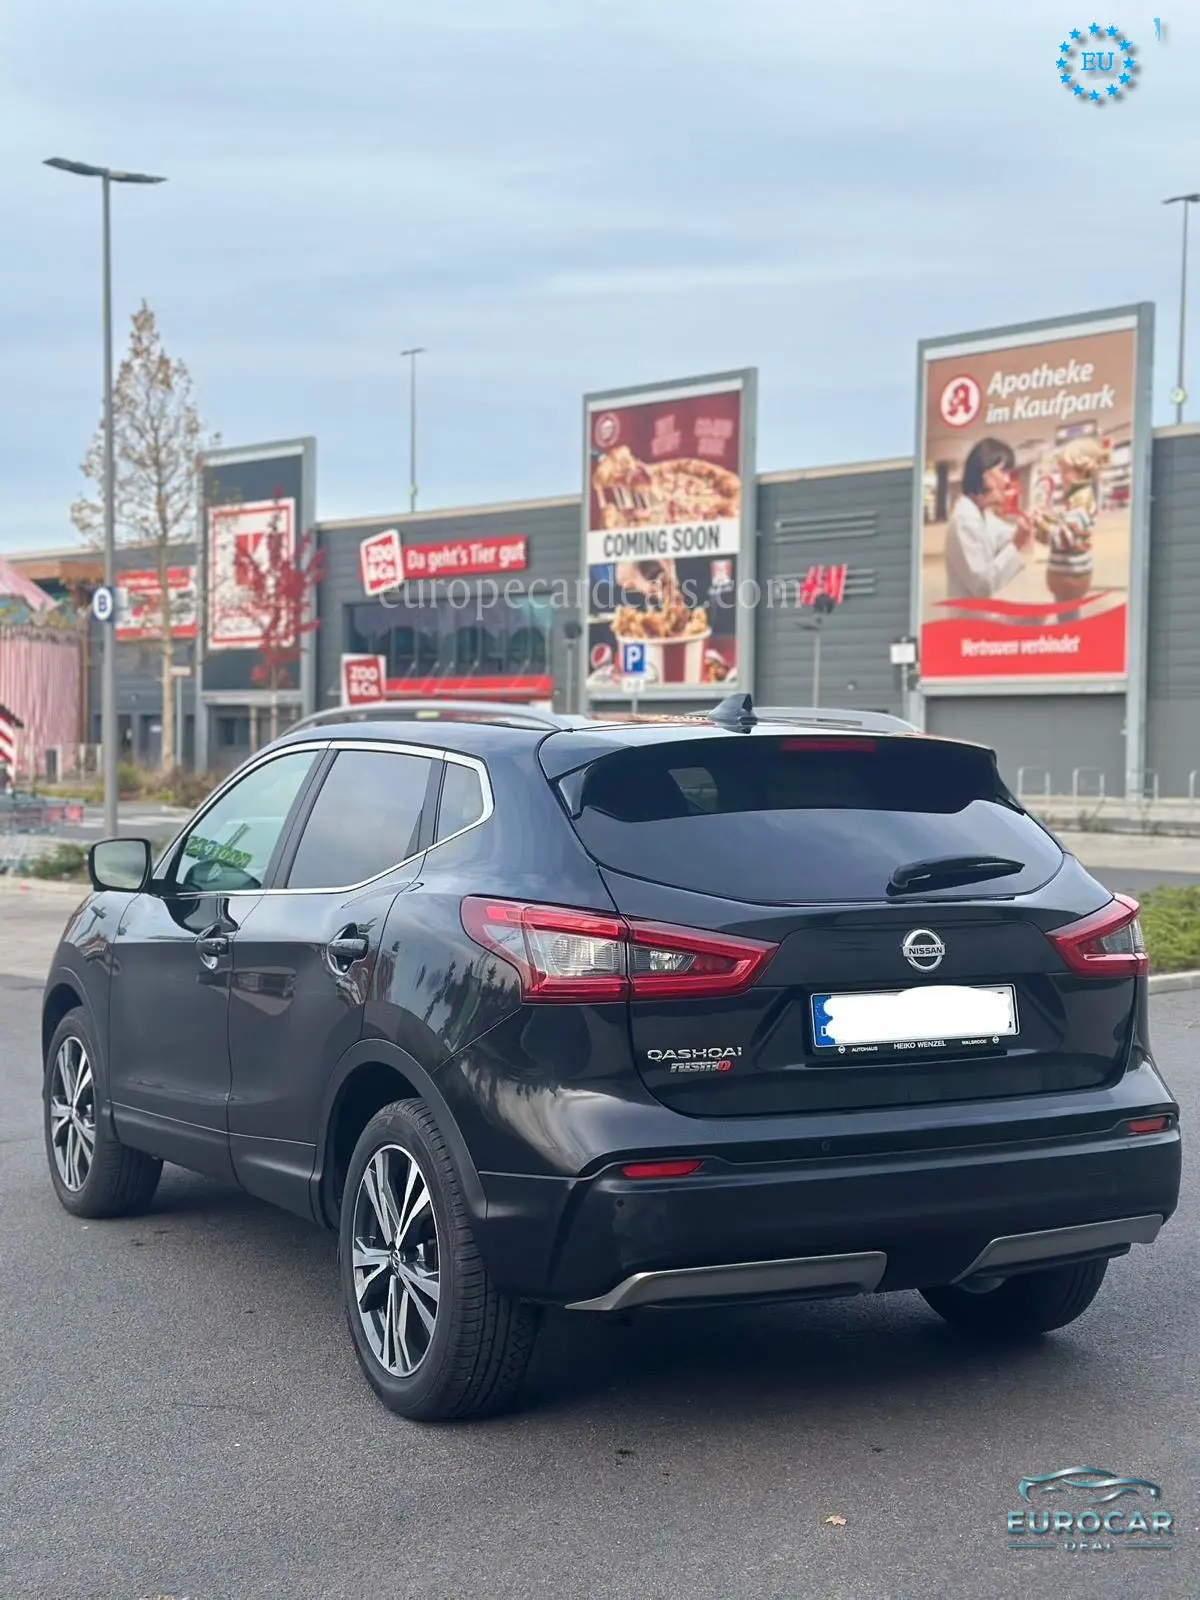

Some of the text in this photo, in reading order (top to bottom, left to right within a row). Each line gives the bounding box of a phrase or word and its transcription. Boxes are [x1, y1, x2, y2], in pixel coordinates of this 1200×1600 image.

[986, 359, 1095, 397] Apotheke
[985, 384, 1116, 424] im Kaufpark
[603, 525, 720, 558] COMING SOON
[407, 541, 526, 572] Da geht's Tier gut
[626, 645, 642, 671] P
[908, 946, 943, 955] NISSAN
[646, 1046, 744, 1063] QASHQAI
[894, 1041, 916, 1050] HEIKO
[917, 1039, 947, 1049] WENZEL
